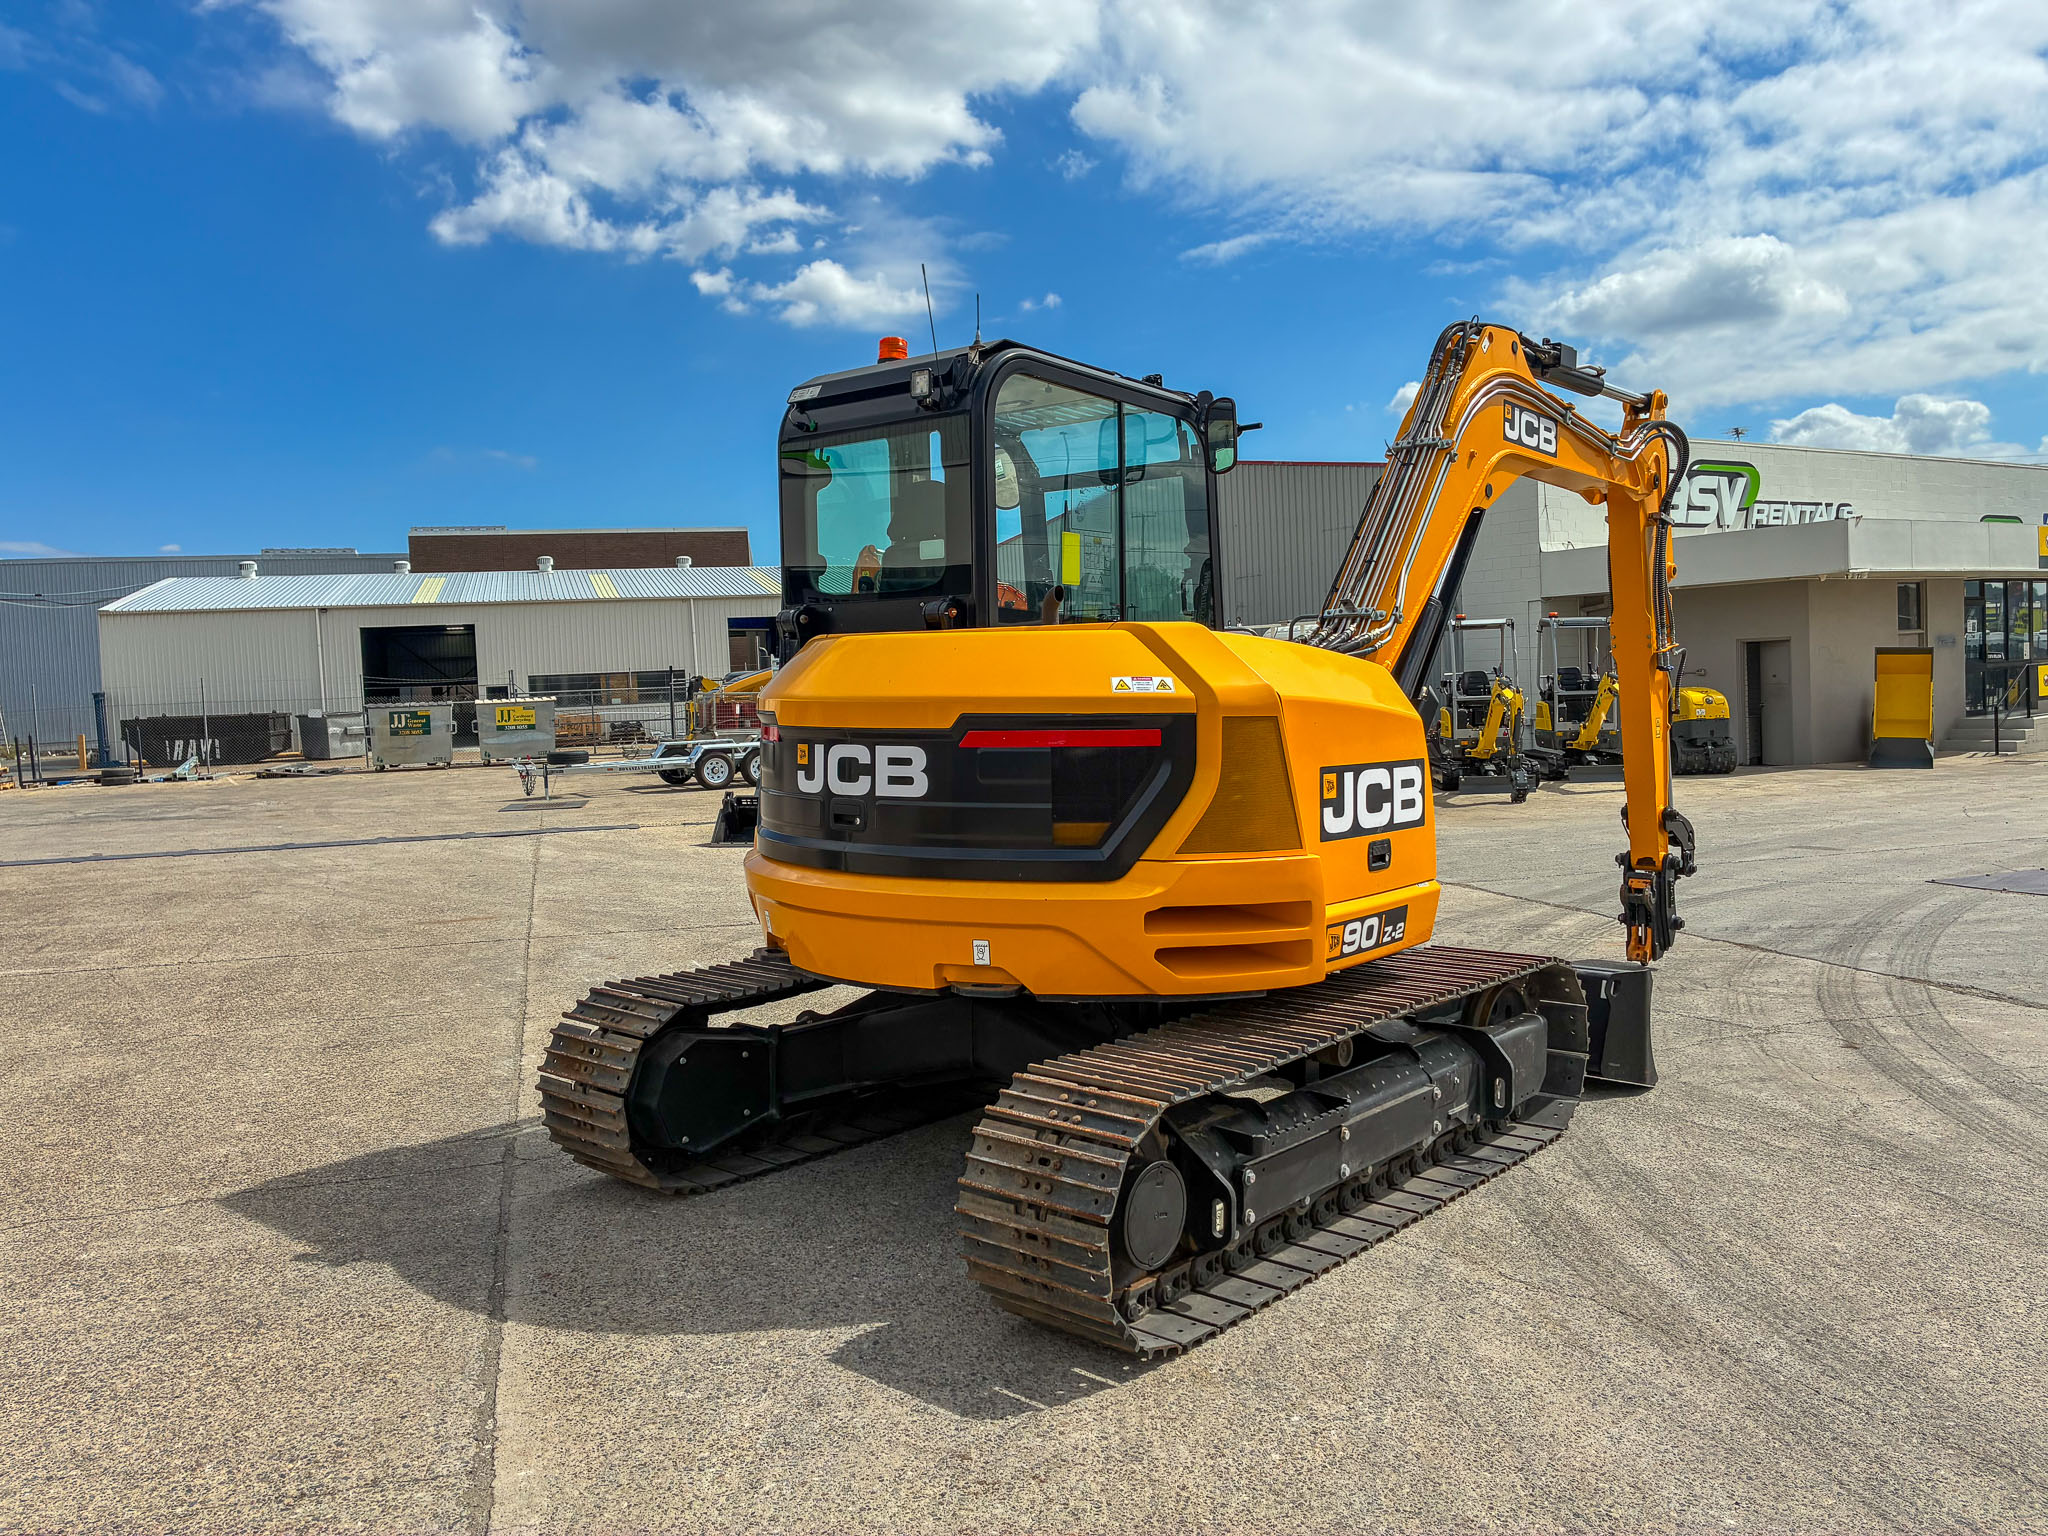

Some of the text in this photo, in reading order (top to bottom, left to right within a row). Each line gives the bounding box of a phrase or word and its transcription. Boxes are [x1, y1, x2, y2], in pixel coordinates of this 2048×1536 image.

[1504, 407, 1557, 454] JCB
[797, 743, 929, 798] JCB
[1323, 765, 1423, 834] JCB
[1342, 916, 1379, 954] 90
